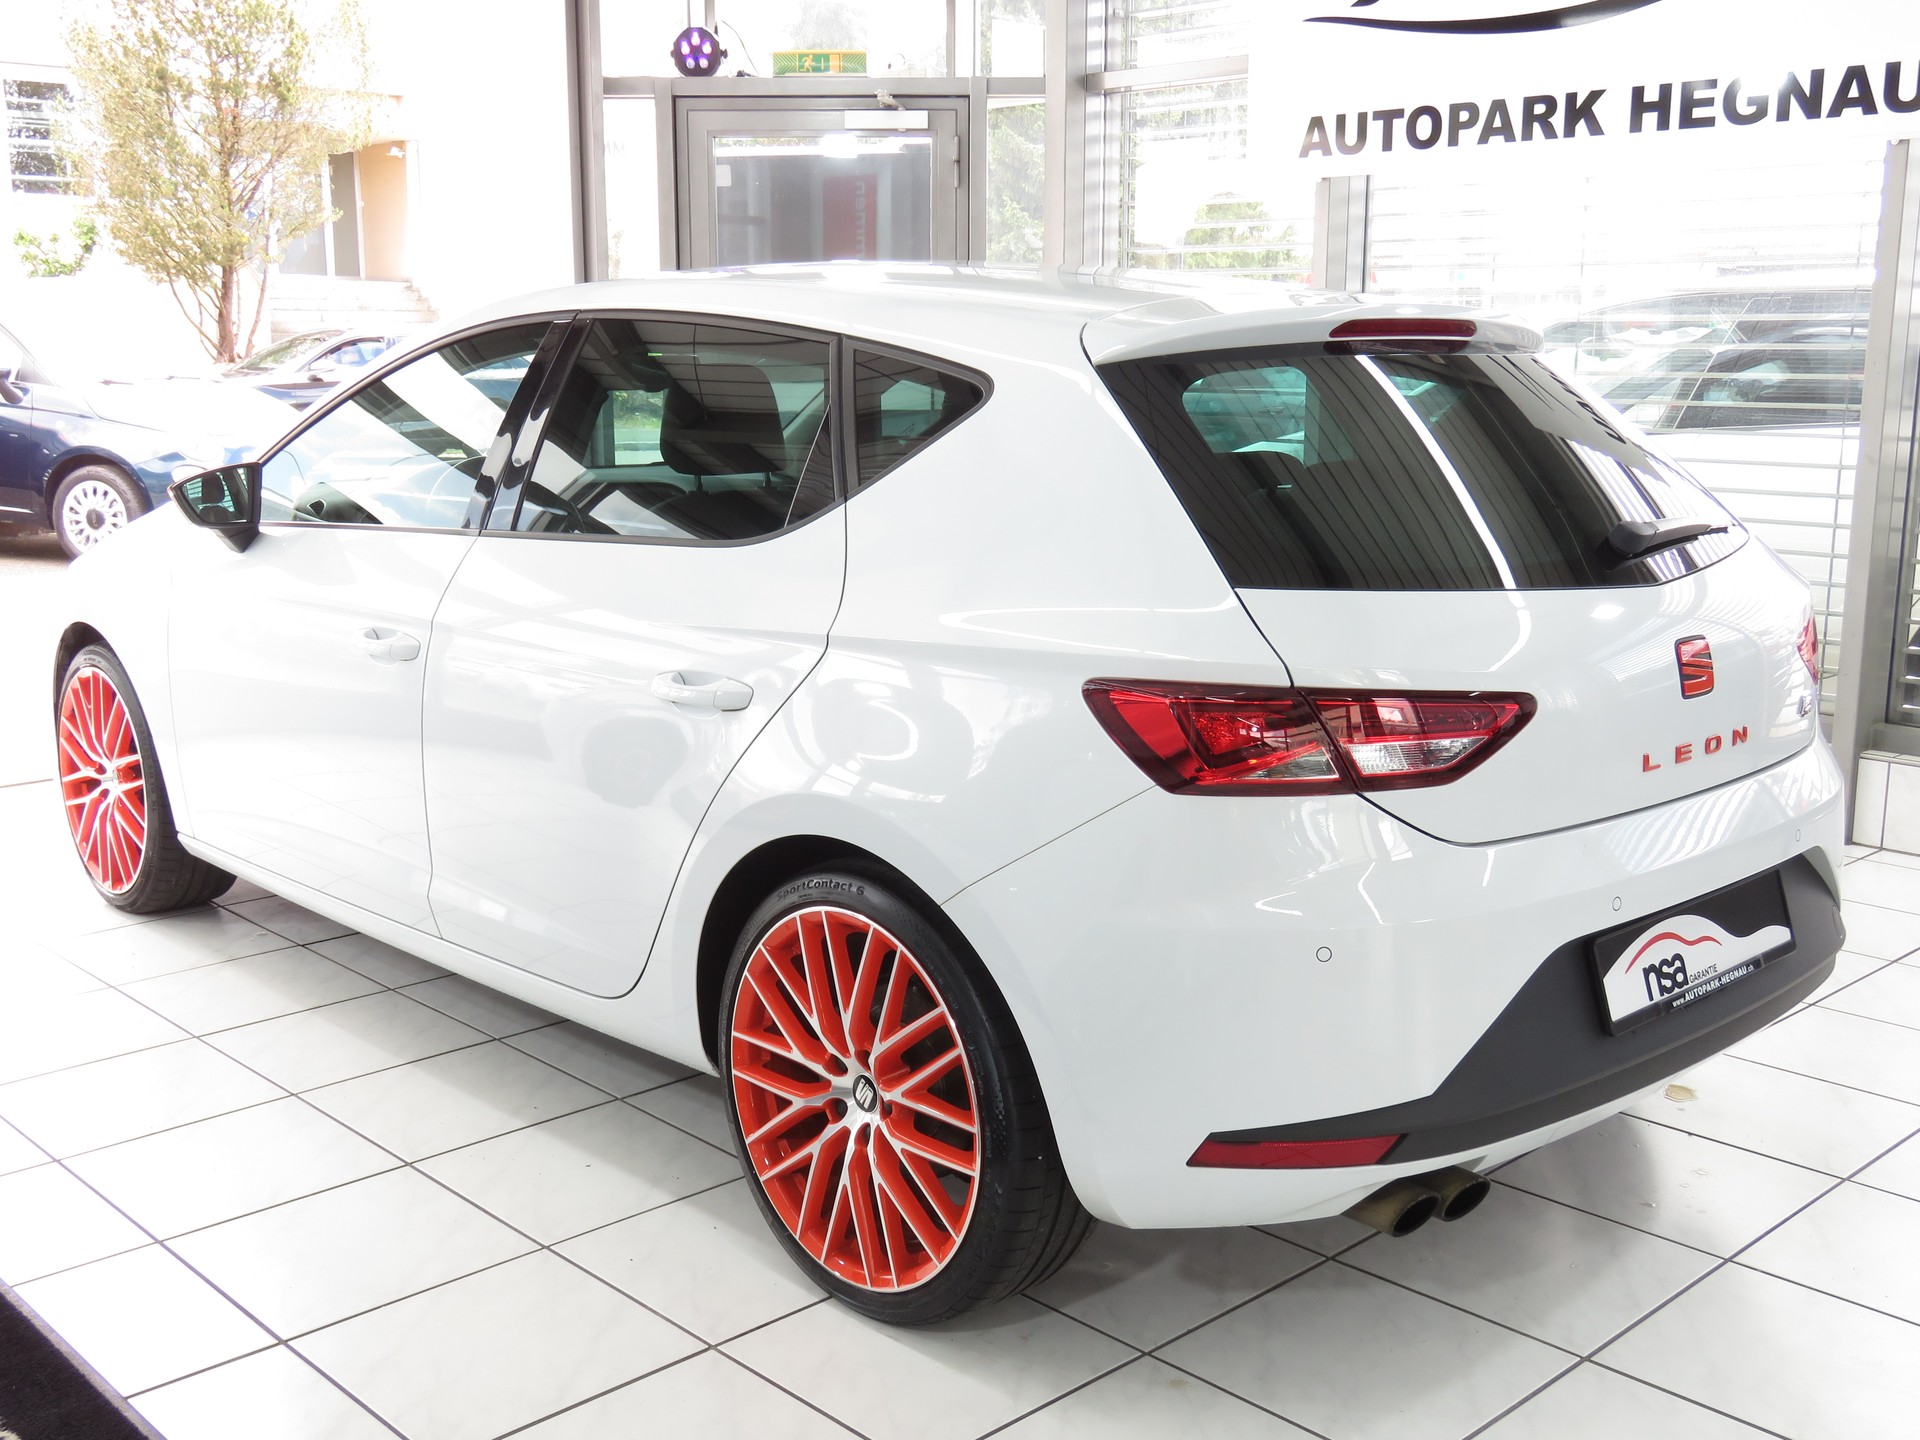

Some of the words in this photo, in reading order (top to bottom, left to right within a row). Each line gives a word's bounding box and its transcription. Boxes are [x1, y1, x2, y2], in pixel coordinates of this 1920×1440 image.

[1298, 88, 1608, 159] AUTOPARK
[1628, 59, 1920, 134] HEGNAU
[1642, 723, 1749, 773] LEON
[776, 878, 853, 902] SportContact
[855, 885, 866, 897] 6
[1641, 952, 1690, 1002] nsa
[1671, 963, 1755, 1008] www.AUTOPARK-HEGNAU.ch
[1688, 963, 1719, 984] GARANTIE
